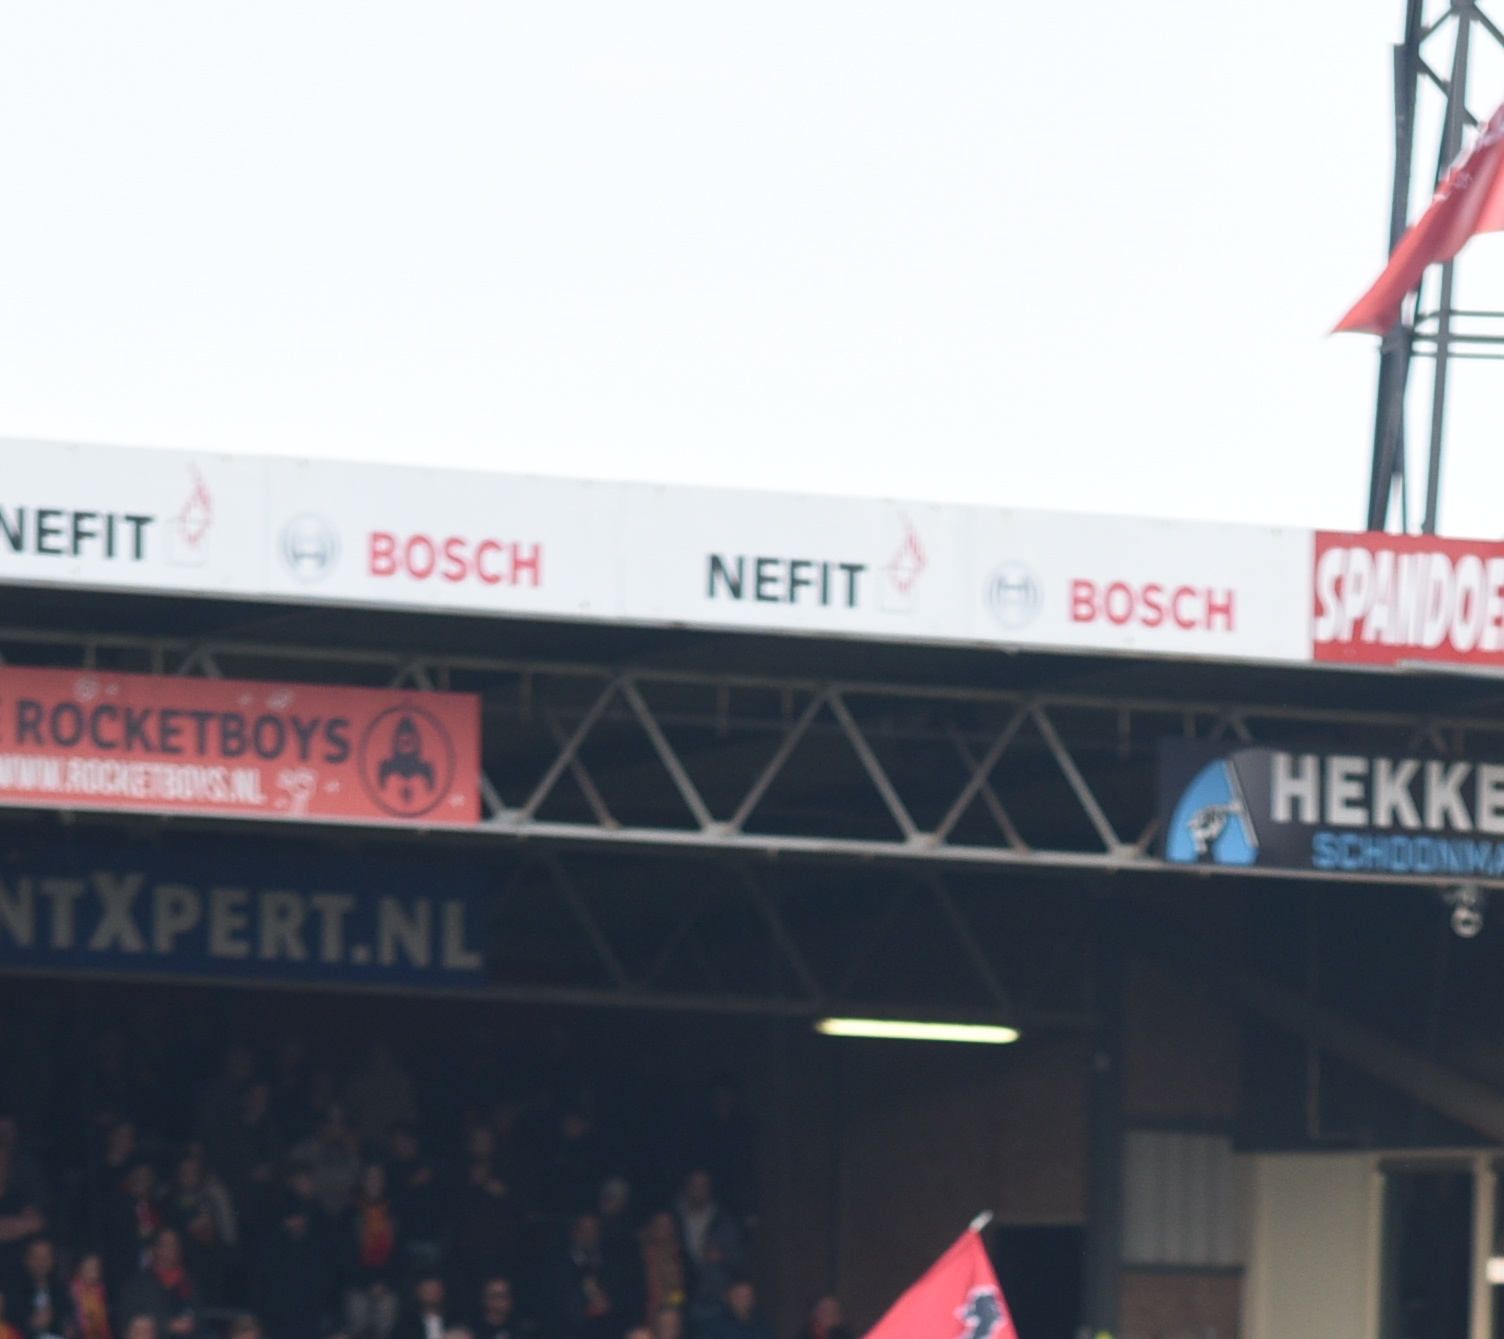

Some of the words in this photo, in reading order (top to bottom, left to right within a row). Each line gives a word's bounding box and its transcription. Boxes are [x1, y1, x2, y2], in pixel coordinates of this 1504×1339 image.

[367, 529, 544, 589] BOSCH
[704, 551, 867, 610] NEFIT
[1069, 578, 1237, 633] BOSCH
[18, 700, 351, 766] ROCKETBOYS
